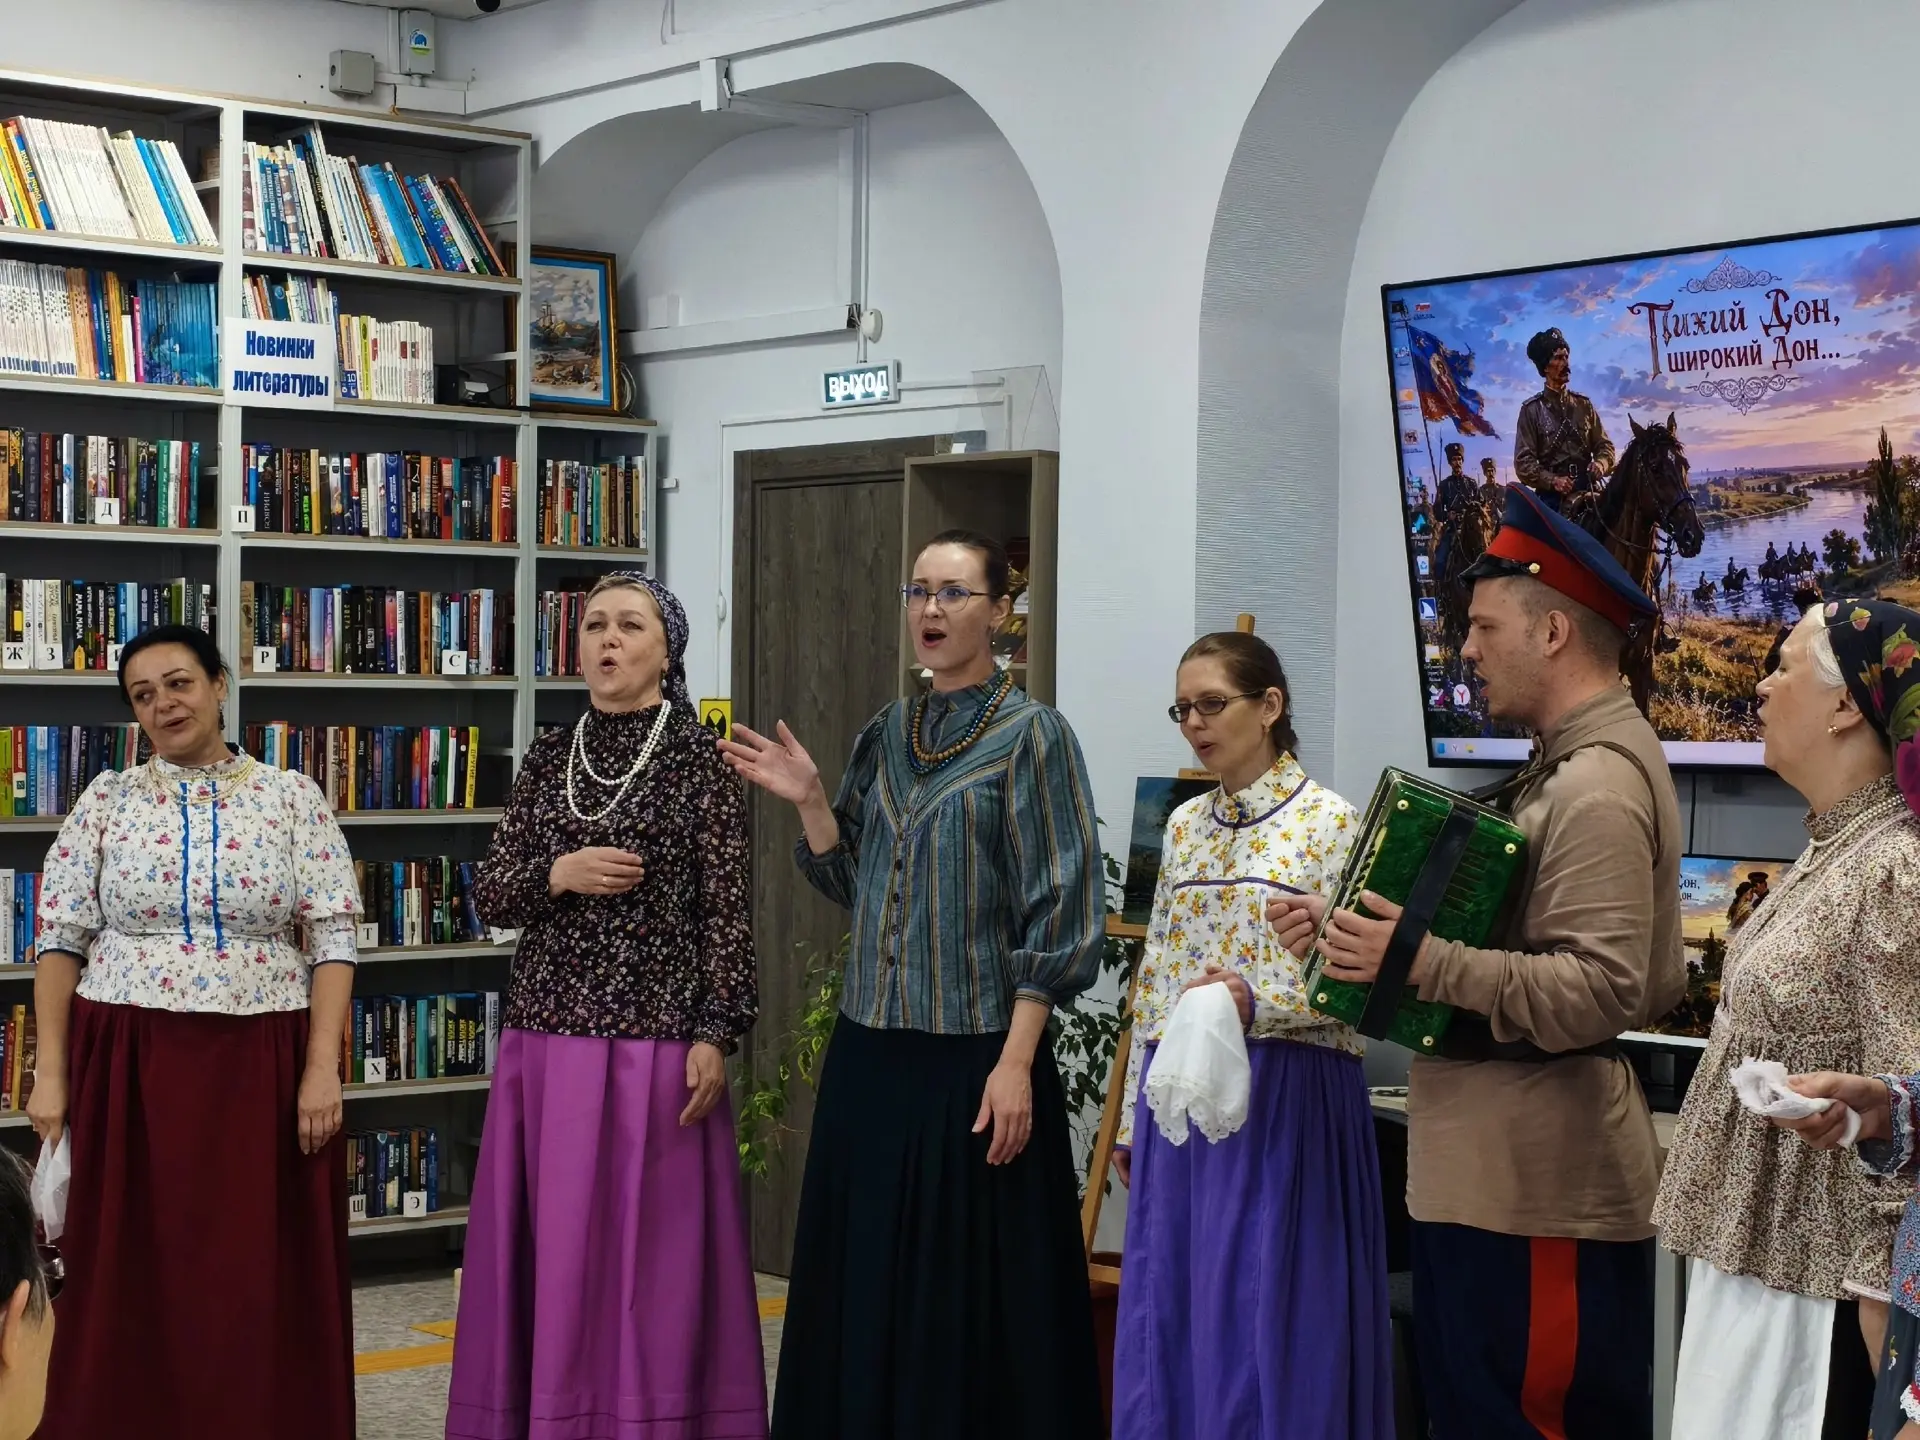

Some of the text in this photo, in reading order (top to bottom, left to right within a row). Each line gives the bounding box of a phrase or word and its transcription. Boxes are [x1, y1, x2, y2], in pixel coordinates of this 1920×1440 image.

[1627, 288, 1841, 381] Тихий Дон,
[246, 330, 315, 360] Новинки
[1667, 336, 1841, 373] широкий Дон...
[233, 370, 329, 397] литературы
[828, 370, 889, 398] ВЫХОД
[501, 486, 511, 509] ПРАХ
[101, 502, 113, 518] Д
[238, 510, 248, 523] П
[6, 646, 24, 660] Ж
[46, 647, 56, 661] З
[261, 651, 270, 663] Р
[449, 654, 461, 667] С
[469, 748, 477, 780] ДРУГИЕ
[362, 927, 373, 941] Т
[370, 1061, 381, 1075] Х
[352, 1199, 364, 1213] Ш
[410, 1196, 420, 1209] Э
